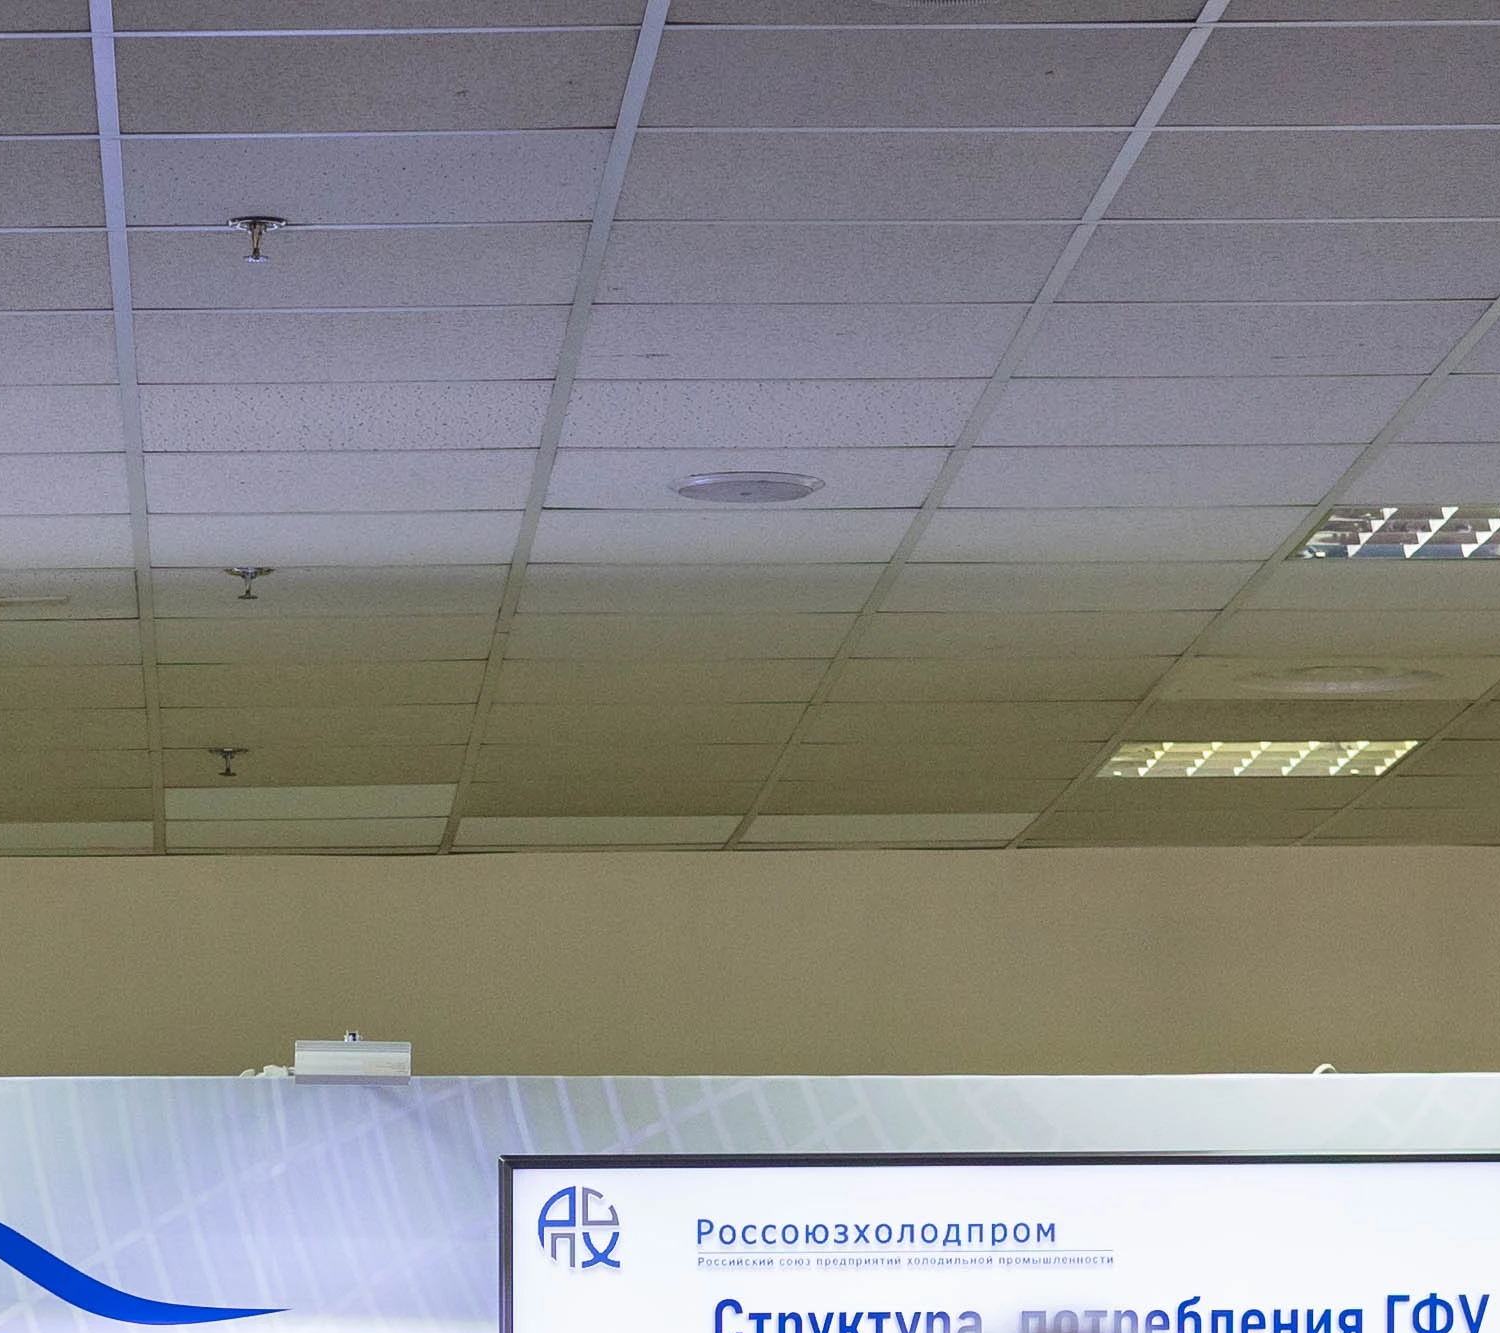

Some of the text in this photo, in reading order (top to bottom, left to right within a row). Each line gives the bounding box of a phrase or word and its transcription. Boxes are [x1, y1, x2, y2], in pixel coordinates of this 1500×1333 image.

[696, 1218, 1058, 1248] Россоюзхолодпром
[697, 1254, 1115, 1268] Российский союз предприятий холодильной промышленности
